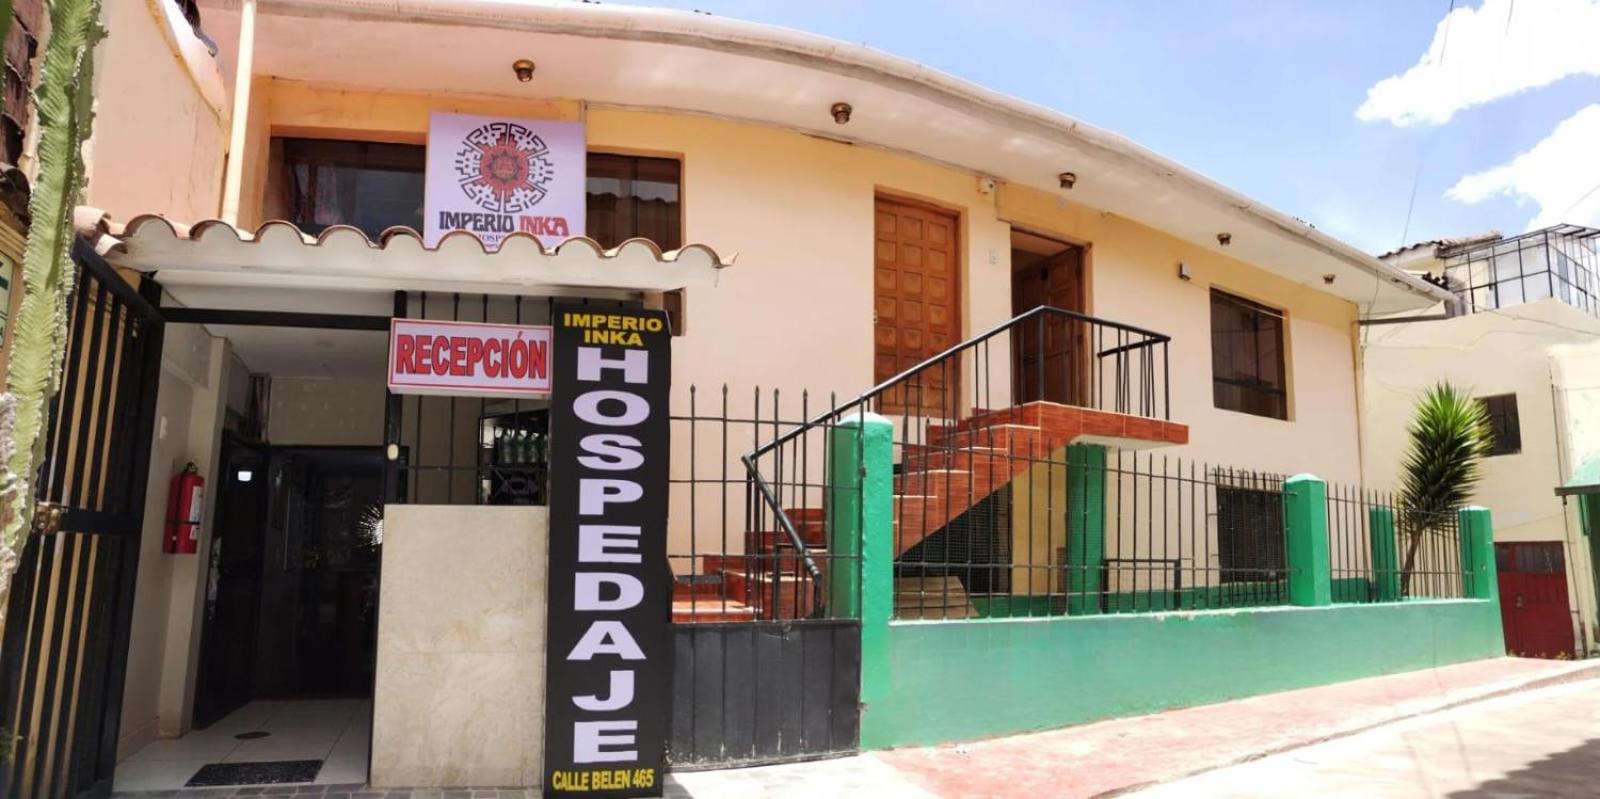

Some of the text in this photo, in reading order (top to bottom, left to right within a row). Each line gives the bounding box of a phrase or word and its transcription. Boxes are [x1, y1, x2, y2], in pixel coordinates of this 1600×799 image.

[439, 211, 570, 237] IMPERIO INKA
[563, 313, 663, 332] IMPERIO
[584, 329, 644, 346] INKA
[396, 331, 548, 380] RECEPCIÓN
[566, 346, 650, 764] HOSPEDAJE
[552, 768, 655, 791] CALLE BELEN 465
